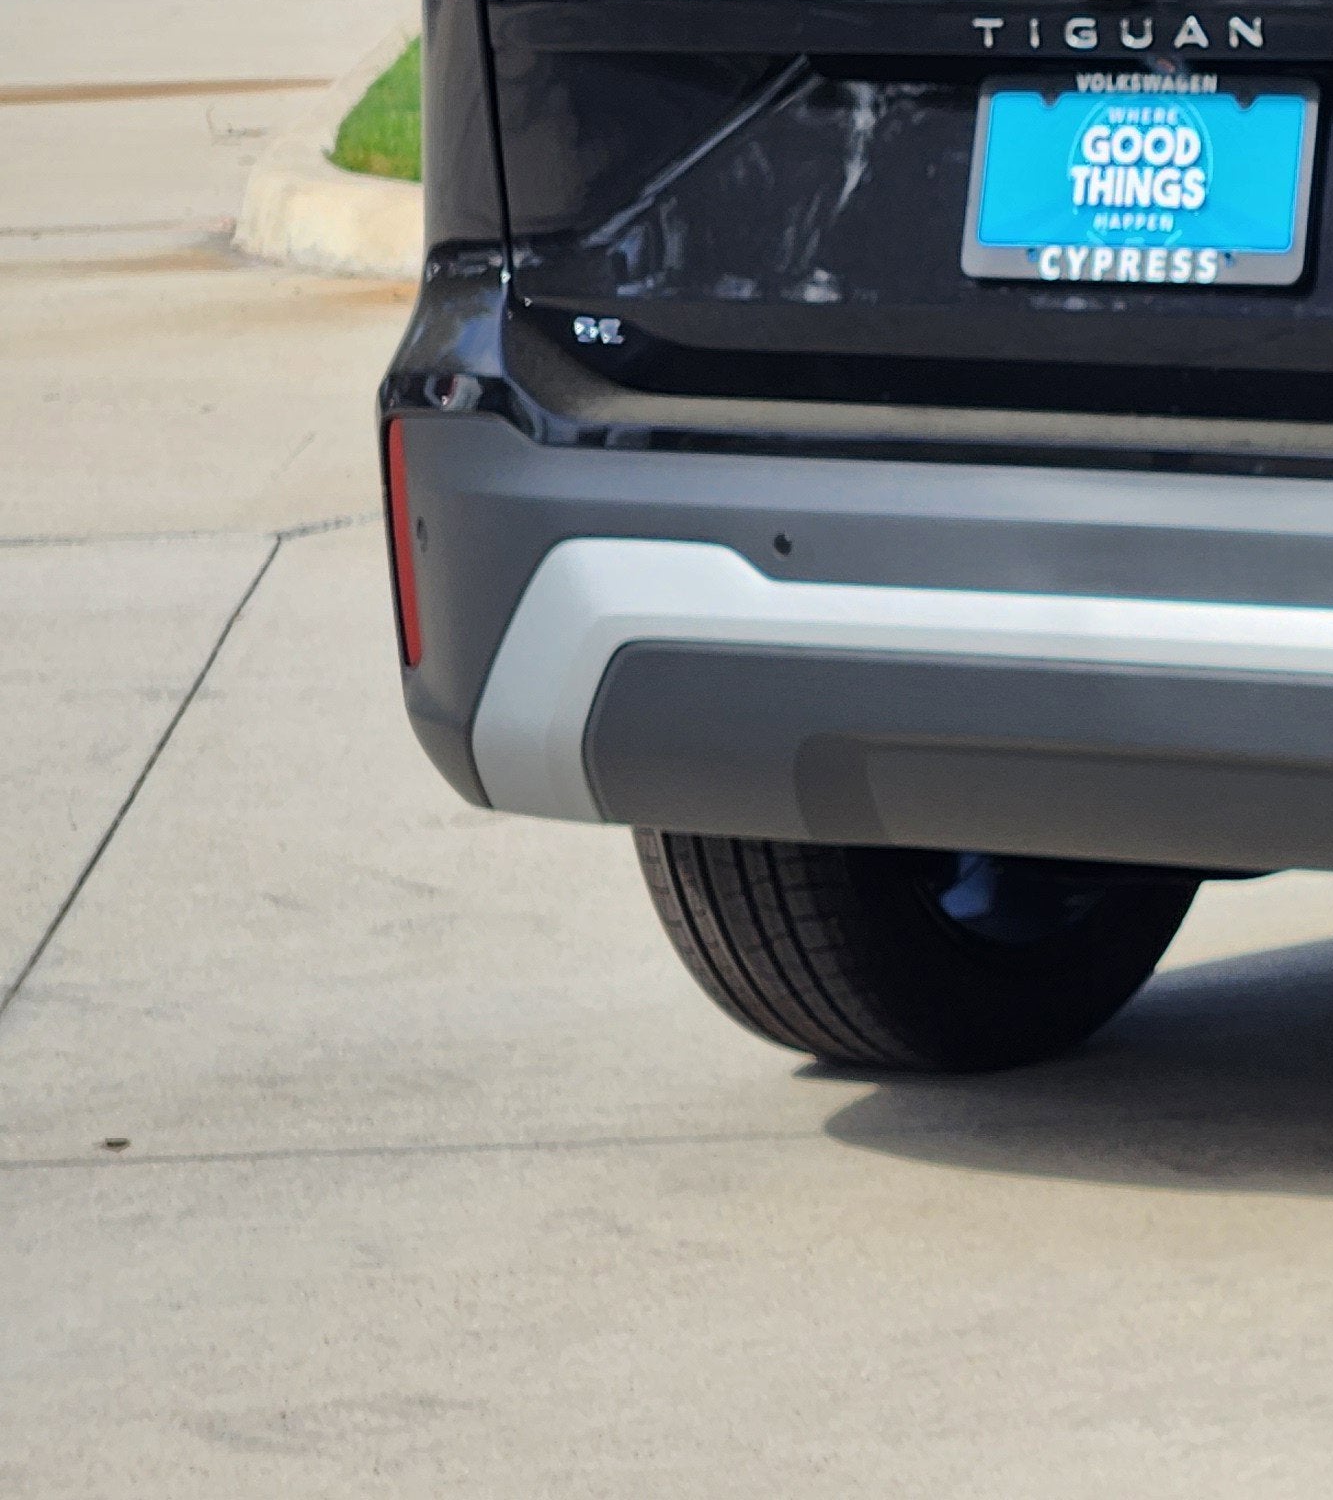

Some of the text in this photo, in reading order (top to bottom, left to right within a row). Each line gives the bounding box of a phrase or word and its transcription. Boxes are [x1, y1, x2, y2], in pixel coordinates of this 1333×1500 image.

[972, 16, 1265, 49] TIGUAN
[1076, 73, 1218, 93] VOLKSWAGEN
[1108, 107, 1179, 125] WHERE
[1082, 125, 1201, 167] GOOD
[1070, 164, 1206, 211] THINGS
[1093, 212, 1174, 233] HAPPEN
[1038, 245, 1219, 284] CYPRESS
